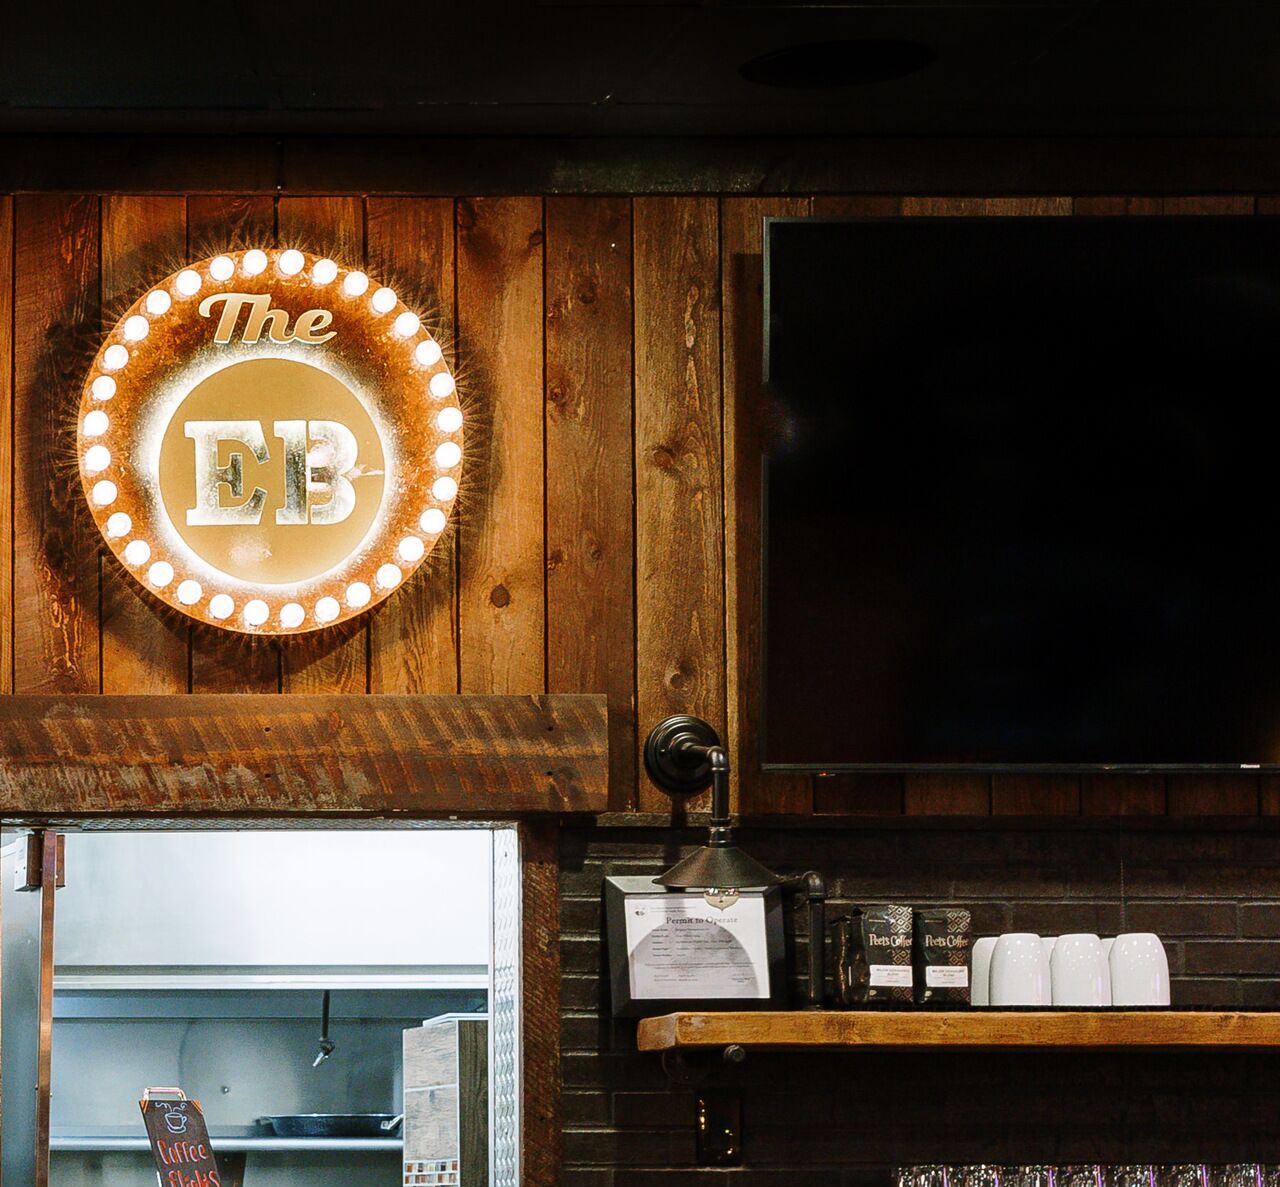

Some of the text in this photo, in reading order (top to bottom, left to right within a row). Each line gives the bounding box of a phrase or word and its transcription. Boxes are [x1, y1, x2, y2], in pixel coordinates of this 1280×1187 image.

[199, 293, 337, 344] The
[184, 420, 358, 526] EB
[157, 1140, 208, 1165] Coffee
